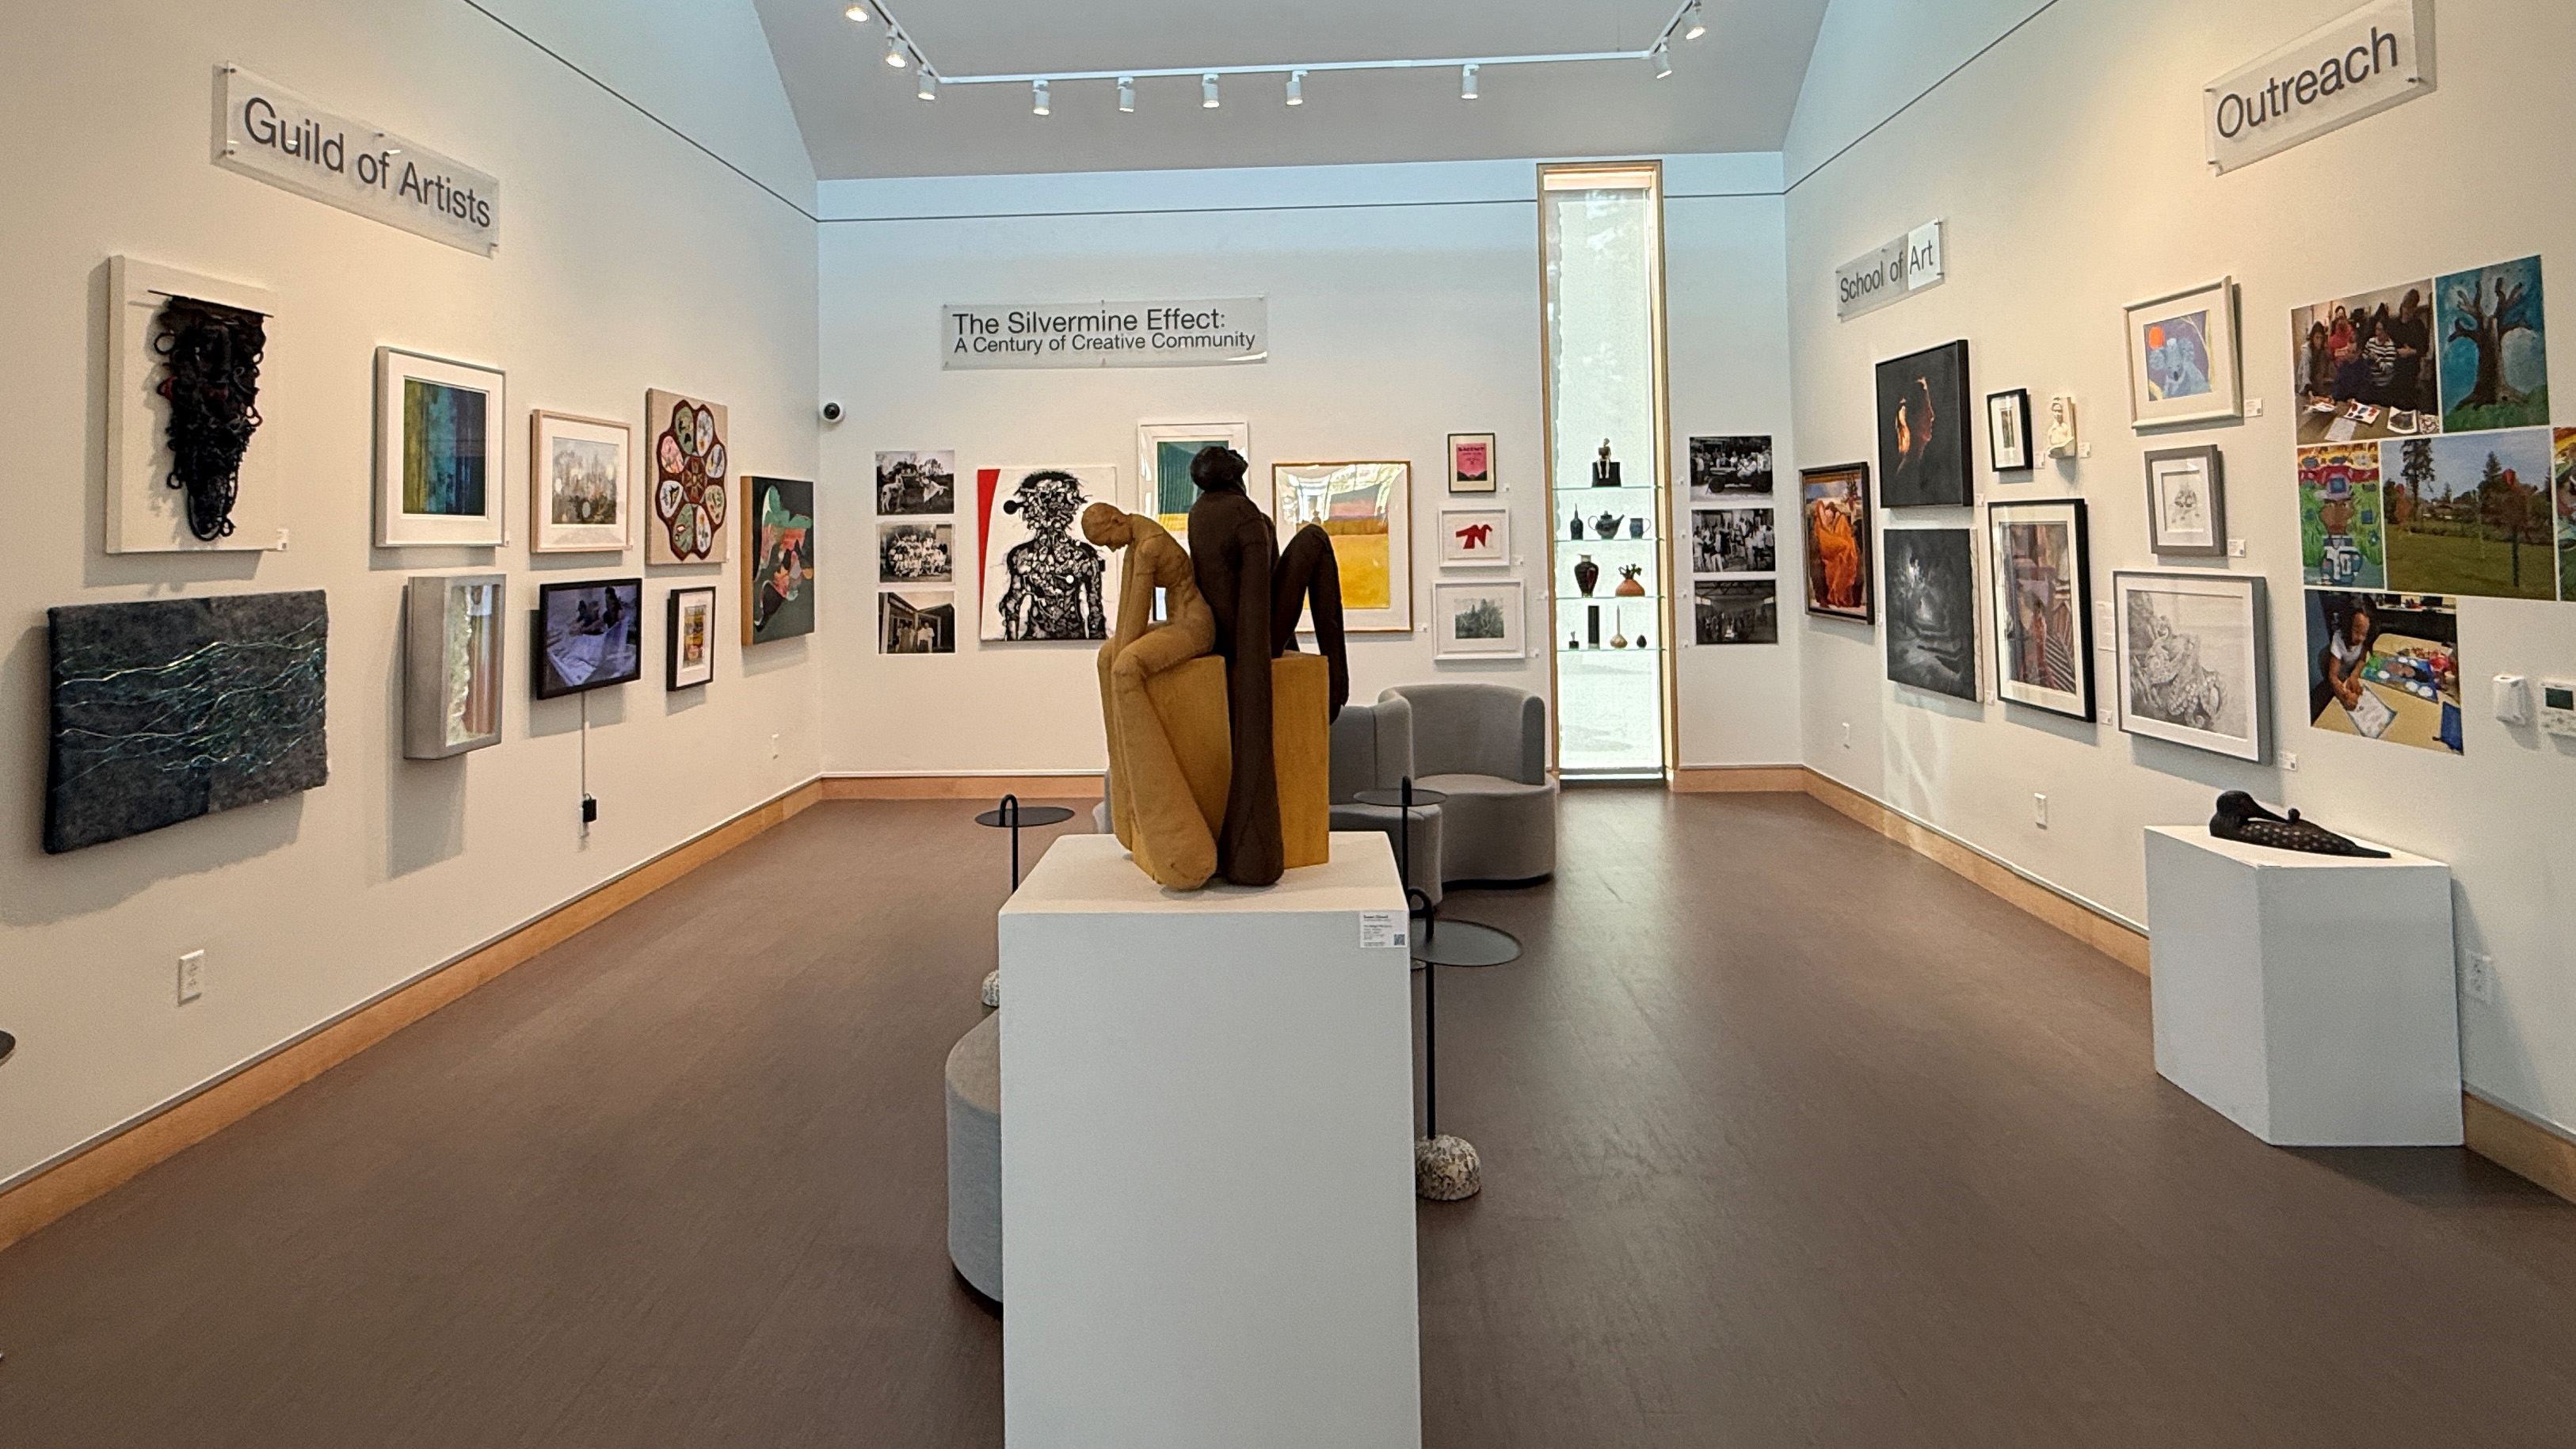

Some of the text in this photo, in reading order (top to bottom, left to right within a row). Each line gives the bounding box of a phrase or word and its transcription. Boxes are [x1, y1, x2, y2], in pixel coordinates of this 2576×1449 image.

[2217, 26, 2398, 138] Outreach
[245, 97, 490, 228] Guild of Artists
[1840, 239, 1934, 303] School of Art
[952, 307, 1225, 335] The Silvermine Effect:
[955, 330, 1256, 355] A Century of Creative Community
